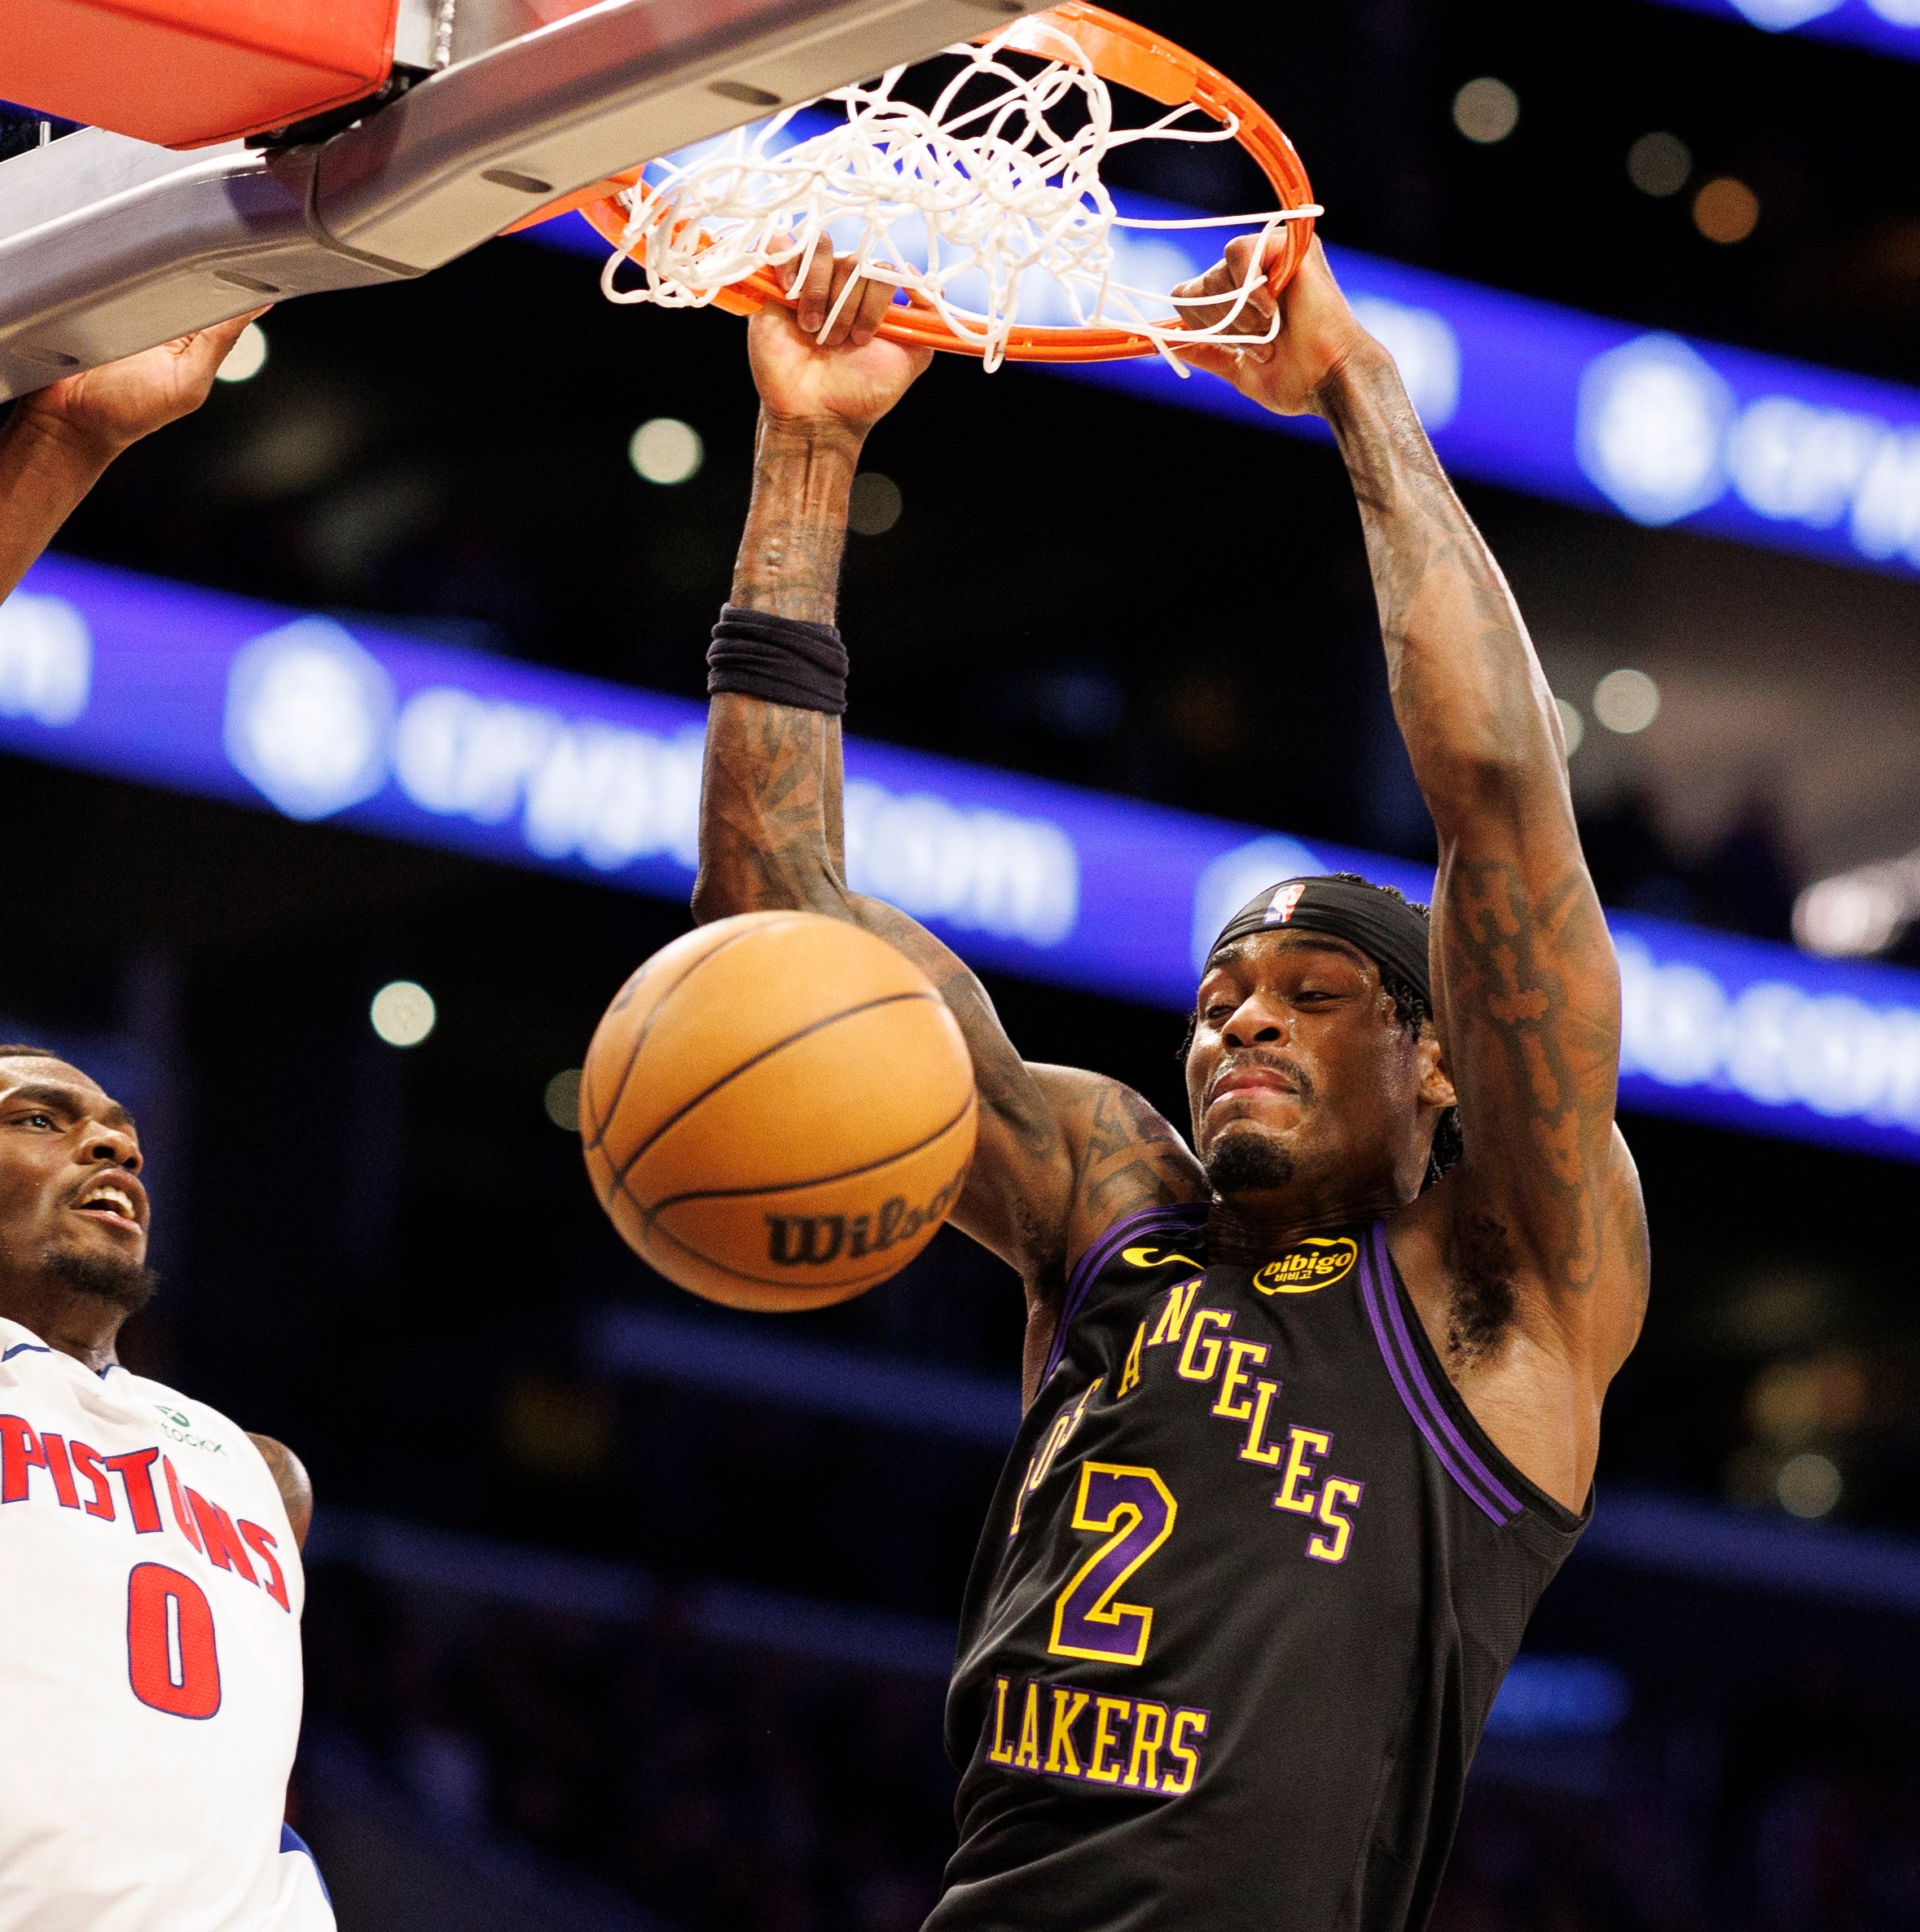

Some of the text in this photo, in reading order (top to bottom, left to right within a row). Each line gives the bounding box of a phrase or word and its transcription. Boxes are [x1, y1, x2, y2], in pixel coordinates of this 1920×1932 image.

[762, 1163, 966, 1267] Wilso
[1263, 1251, 1352, 1276] bibigo
[1117, 1274, 1364, 1565] ANGELES
[1048, 1462, 1178, 1666] 2
[127, 1561, 222, 1720] 0
[986, 1674, 1211, 1796] LAKERS
